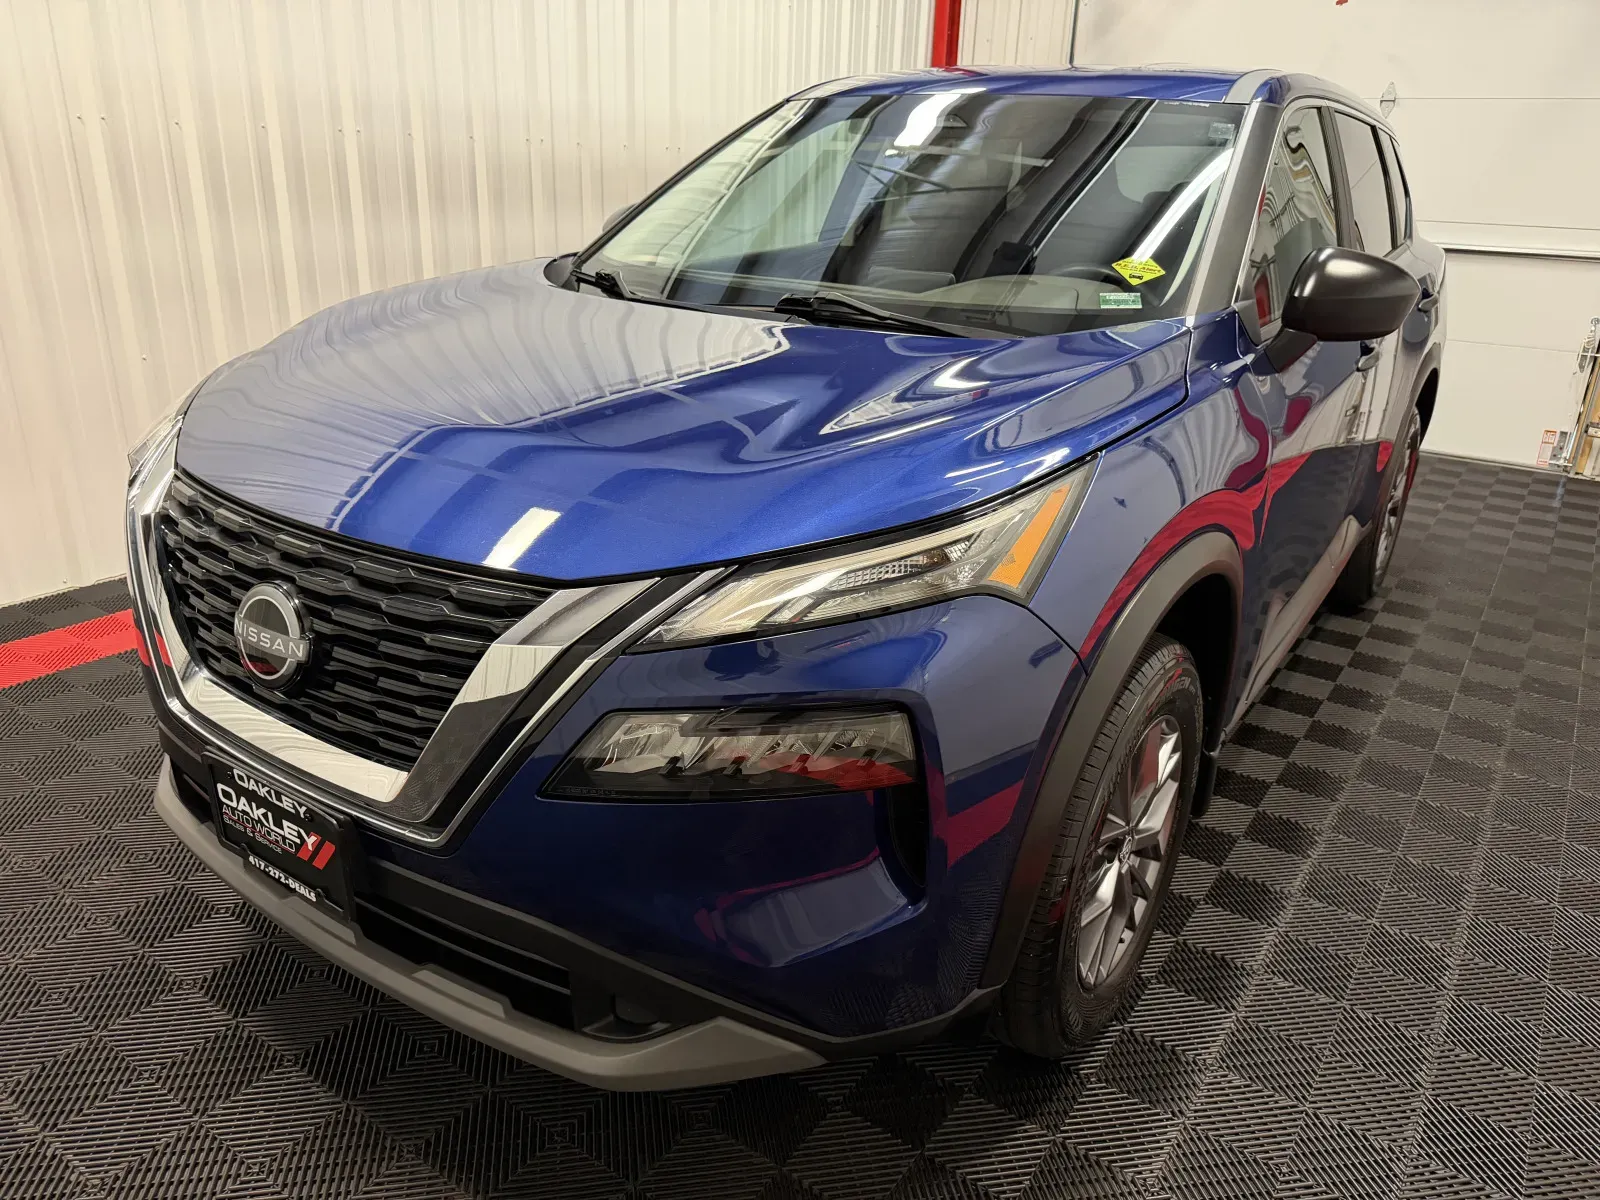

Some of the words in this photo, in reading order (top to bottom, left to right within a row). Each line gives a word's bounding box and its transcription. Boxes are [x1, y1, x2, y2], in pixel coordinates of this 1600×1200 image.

[235, 617, 304, 658] NISSAN
[216, 783, 318, 851] OAKLEY
[233, 768, 308, 819] OAKLEY
[222, 804, 253, 828] AUTO
[254, 821, 296, 852] WORLD
[248, 855, 317, 902] 417-272-DEALS
